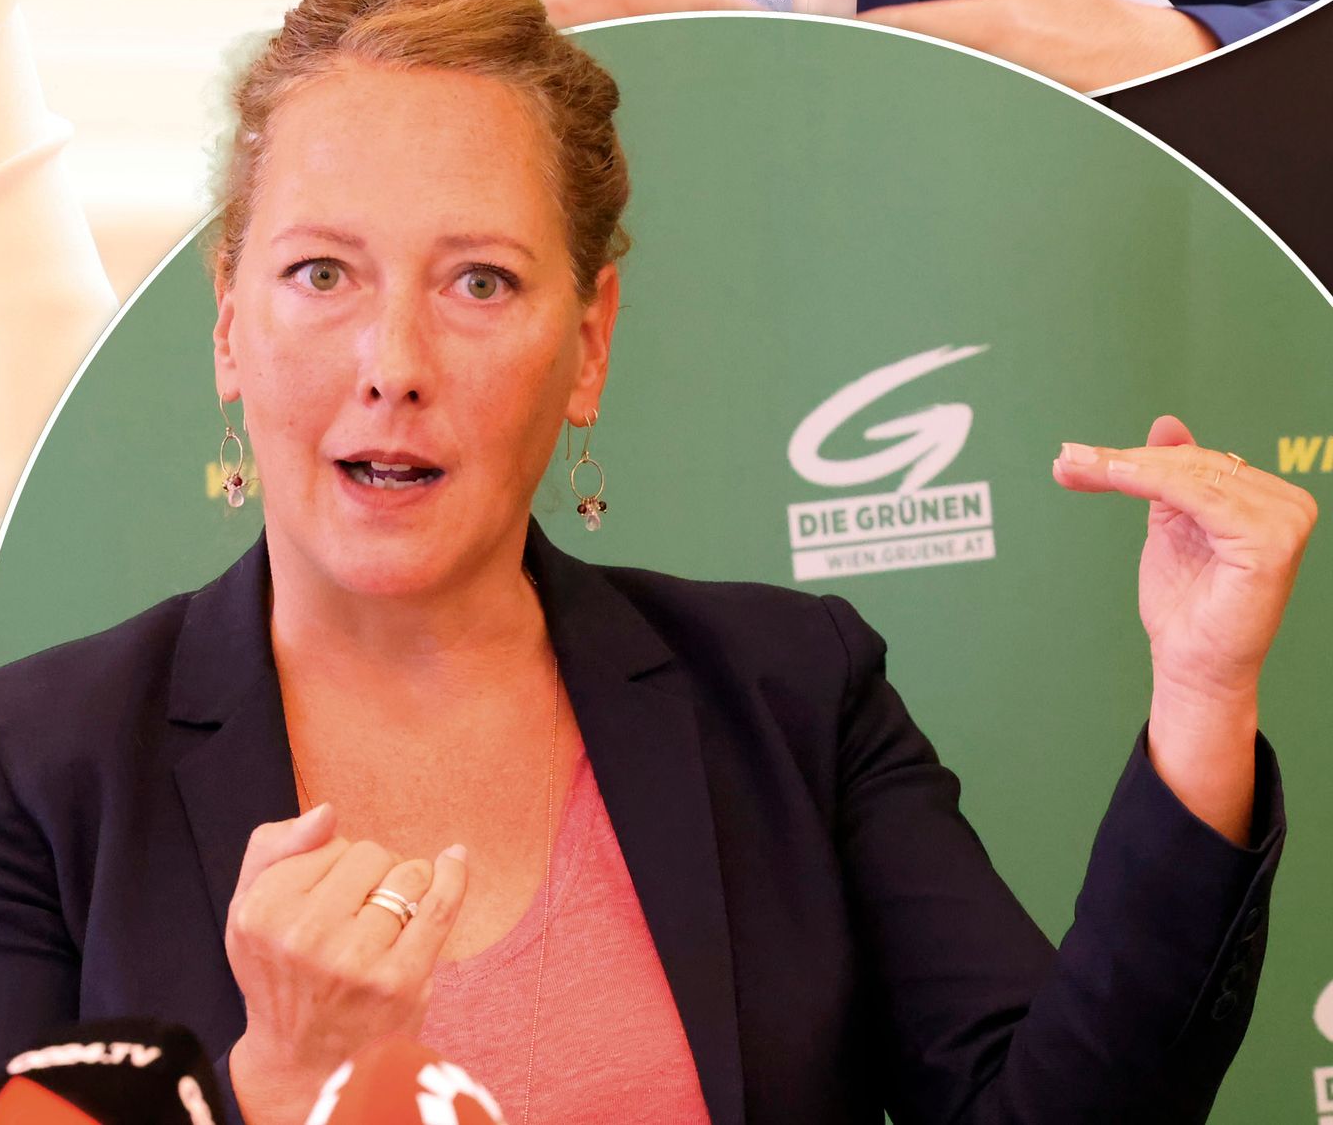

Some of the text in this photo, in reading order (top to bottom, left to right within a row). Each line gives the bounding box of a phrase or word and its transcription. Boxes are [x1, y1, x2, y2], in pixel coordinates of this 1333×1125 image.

[798, 492, 982, 538] DIE GRÜNEN
[826, 536, 986, 572] WIEN.GRUENE.AT
